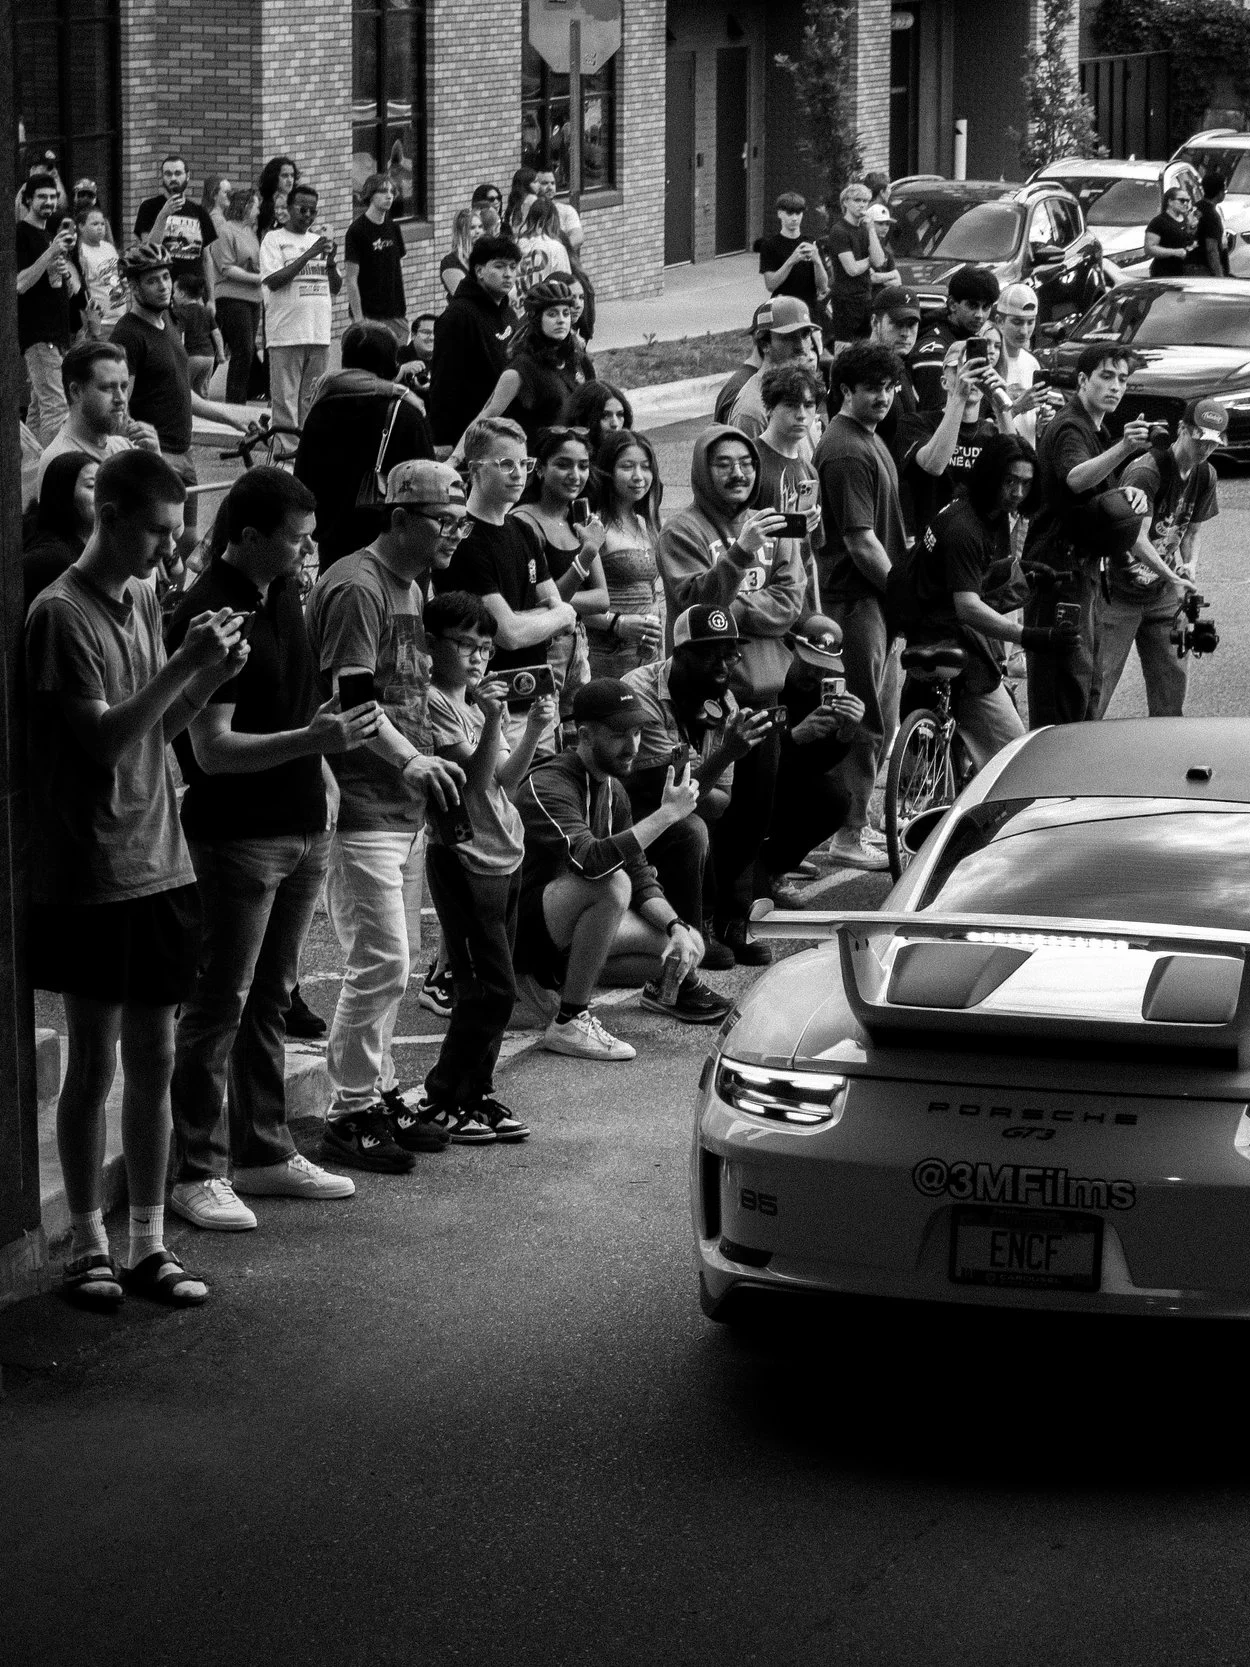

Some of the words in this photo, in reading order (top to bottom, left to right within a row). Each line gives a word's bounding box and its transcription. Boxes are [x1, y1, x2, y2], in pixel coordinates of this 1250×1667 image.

[928, 1102, 1138, 1126] PORSCHE
[1002, 1126, 1056, 1140] GT3
[912, 1157, 1136, 1211] @3MFilms
[990, 1230, 1062, 1271] ENCF
